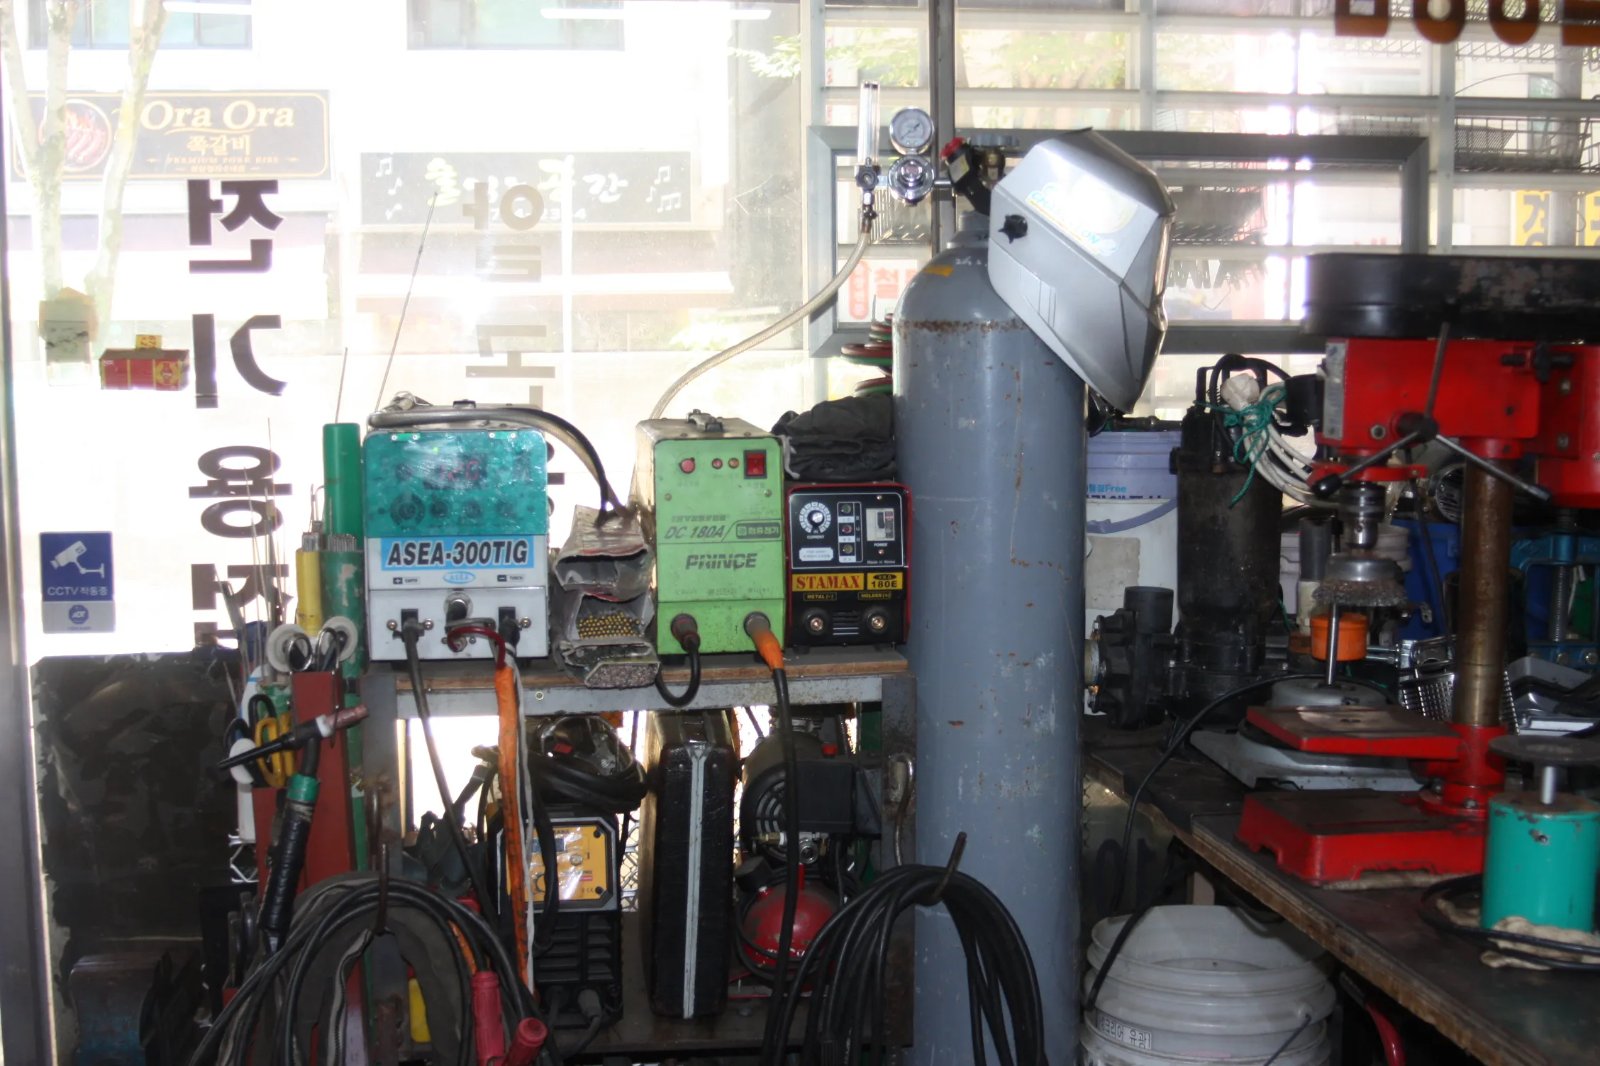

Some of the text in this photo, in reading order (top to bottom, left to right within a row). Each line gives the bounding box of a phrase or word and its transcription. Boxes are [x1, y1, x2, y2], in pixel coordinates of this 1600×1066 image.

[141, 100, 294, 130] Ora Ora
[664, 526, 687, 539] DC
[690, 525, 725, 538] 180A
[388, 540, 528, 565] ASEA-300TIG
[685, 553, 758, 570] PRINCE
[796, 575, 861, 590] STAMAX
[48, 586, 108, 596] CCTV 작동중
